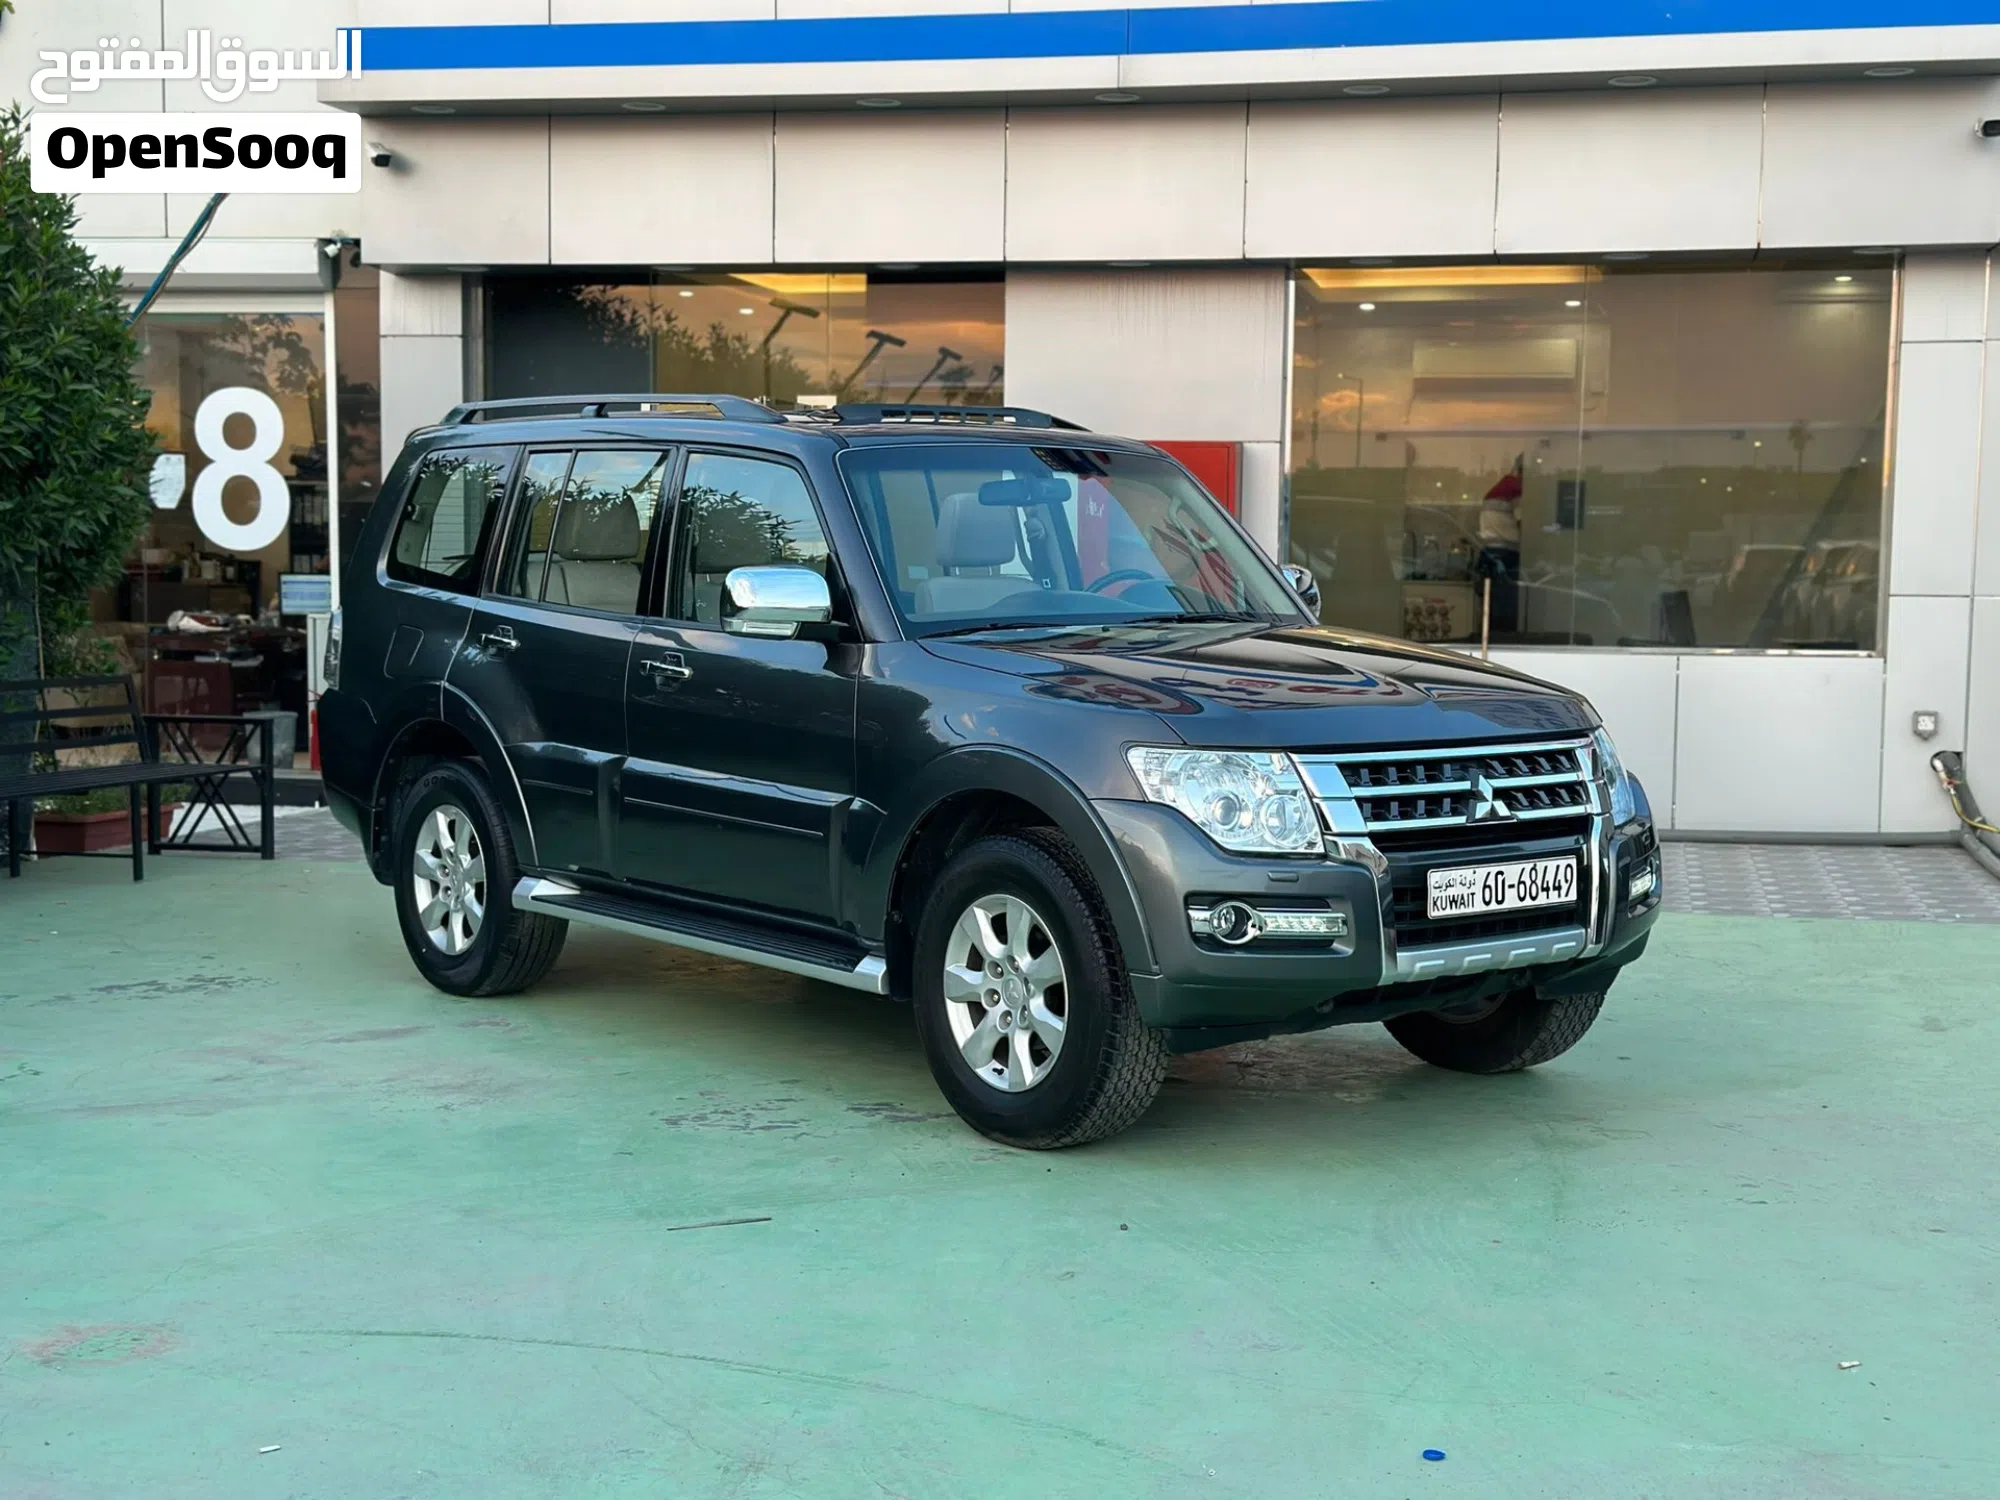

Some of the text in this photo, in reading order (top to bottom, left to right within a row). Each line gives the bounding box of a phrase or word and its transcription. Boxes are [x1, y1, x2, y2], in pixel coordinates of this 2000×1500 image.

[192, 386, 291, 551] 8
[1432, 877, 1457, 893] الكويت
[1482, 863, 1574, 906] 60-68449
[1432, 892, 1476, 912] KUWAIT
